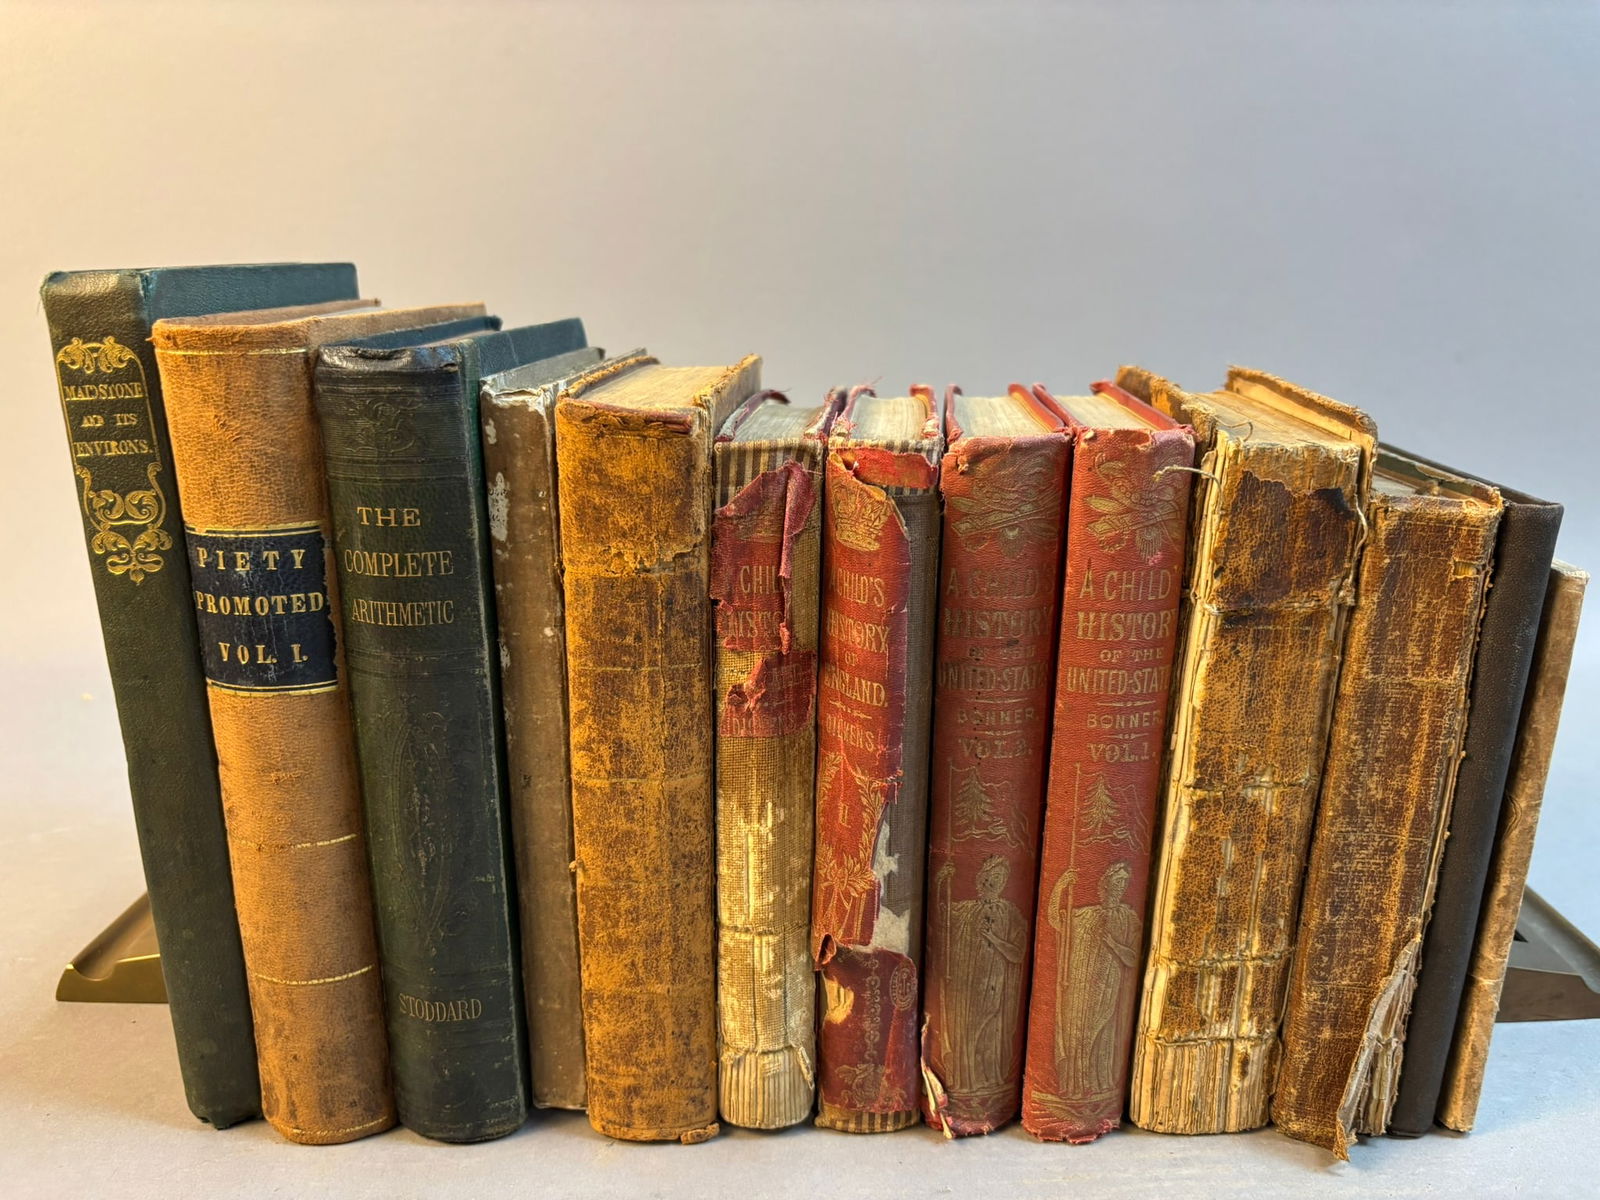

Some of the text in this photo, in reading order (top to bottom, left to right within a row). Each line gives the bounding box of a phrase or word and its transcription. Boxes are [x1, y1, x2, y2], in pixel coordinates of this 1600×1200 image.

[64, 382, 144, 401] MAIDSTONE
[81, 413, 138, 428] AND ITS
[357, 507, 421, 527] THE
[196, 547, 306, 571] PIETY
[344, 549, 454, 577] COMPLETE
[1079, 567, 1096, 600] A
[195, 591, 324, 616] PROMOTED
[351, 599, 455, 627] ARITHMETIC
[826, 607, 891, 654] HISTORY
[218, 642, 278, 665] VOL.
[1100, 647, 1165, 663] OF THE
[399, 992, 482, 1022] STODDARD
